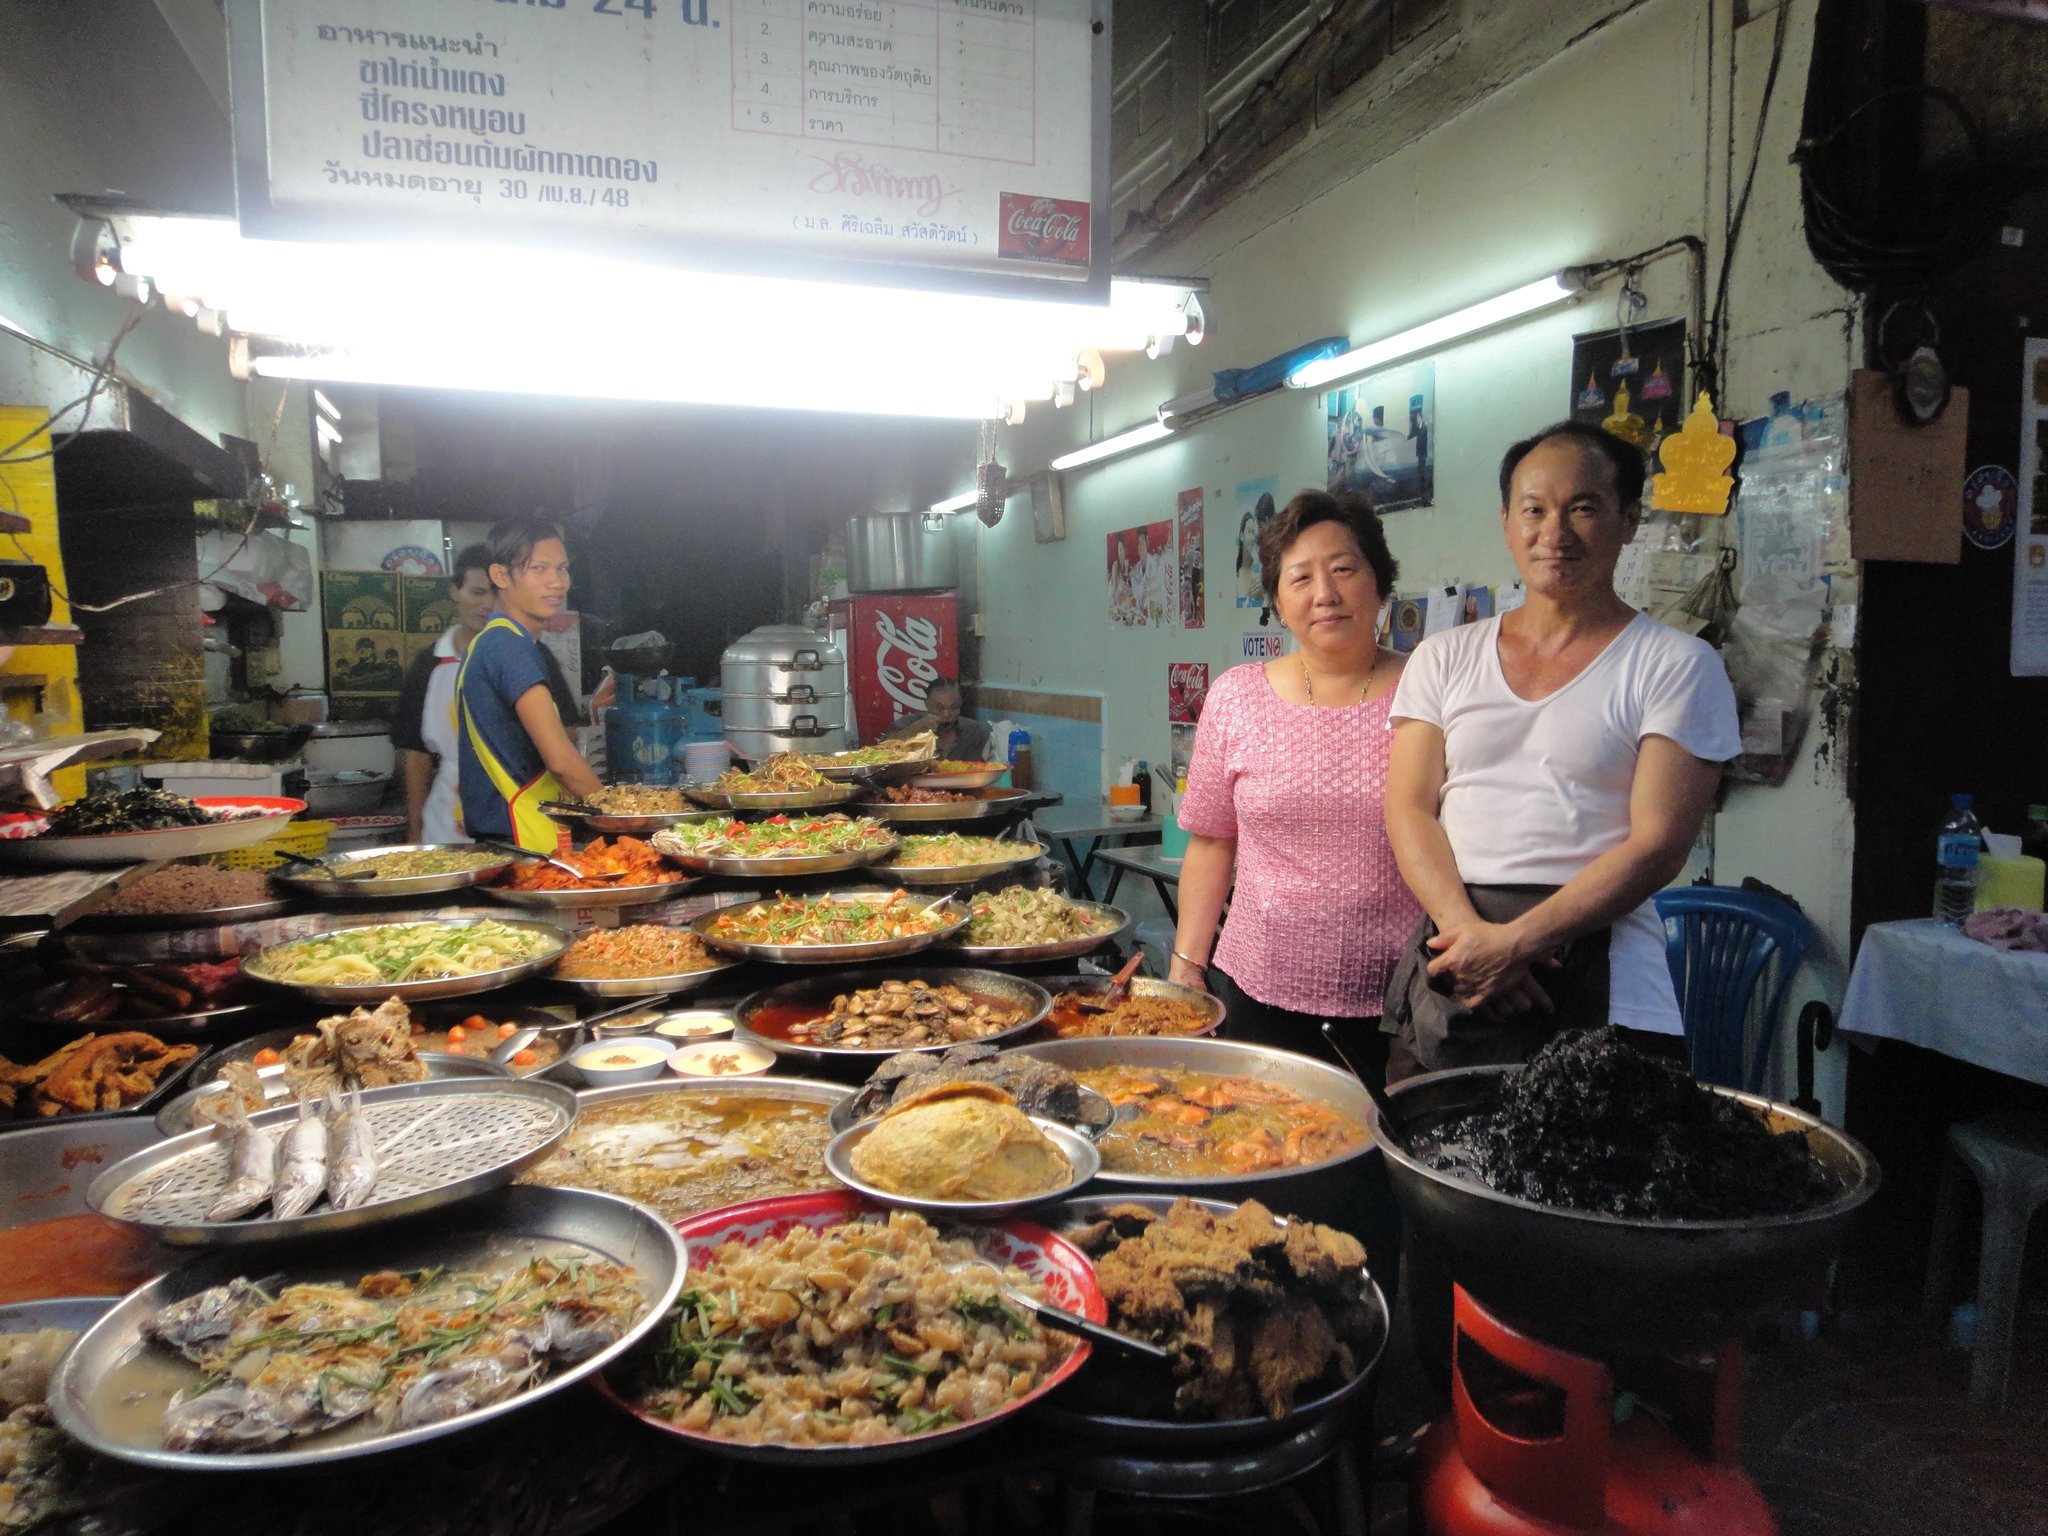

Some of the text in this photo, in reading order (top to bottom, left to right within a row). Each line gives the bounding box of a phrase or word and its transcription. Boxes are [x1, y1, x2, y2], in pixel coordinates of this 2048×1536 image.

[317, 22, 498, 58] อาหารแนะนำ
[760, 23, 892, 52] 2. ความสะอาด
[359, 57, 506, 98] ขาไก่น้ำแดง
[760, 52, 932, 87] 3. คุณภาพของวัตถุดิบ
[808, 89, 879, 108] การบริการ
[760, 111, 843, 134] 5. ราคา
[322, 159, 482, 204] วันหมดอายุ
[499, 178, 528, 200] 30
[1007, 208, 1082, 241] Coca-Cola
[1242, 636, 1265, 657] VOTE
[1170, 663, 1206, 689] Coca-Cola
